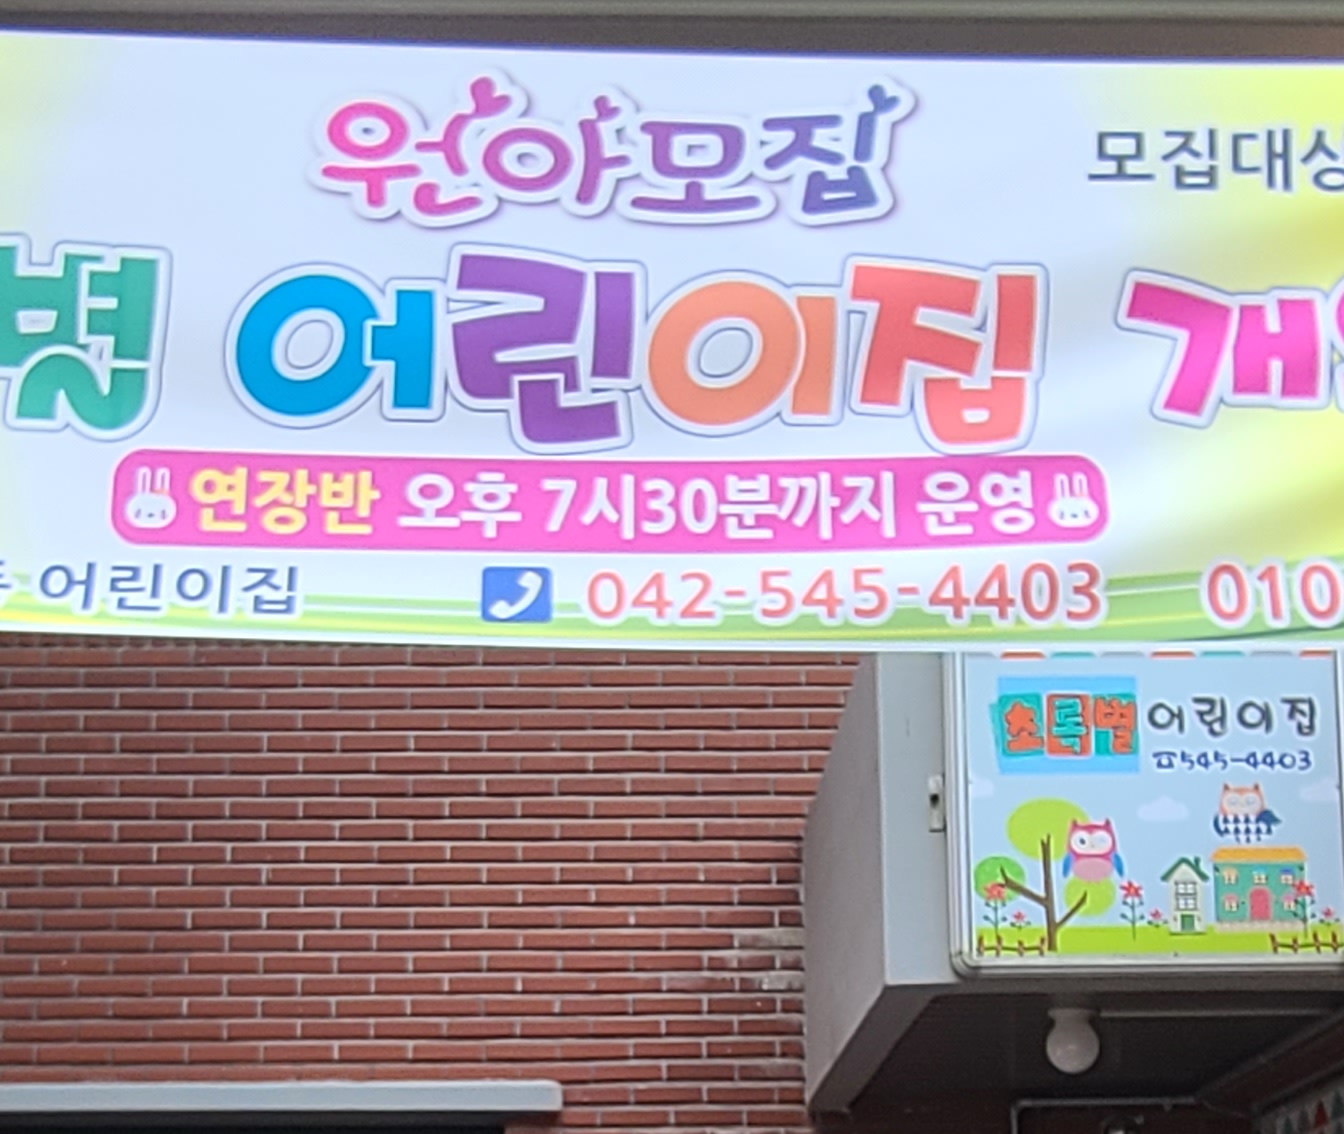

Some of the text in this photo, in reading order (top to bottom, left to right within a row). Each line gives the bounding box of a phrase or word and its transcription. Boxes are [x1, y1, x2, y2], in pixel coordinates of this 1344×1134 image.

[321, 76, 901, 215] 원아모집
[232, 250, 1042, 449] 어린이집
[188, 465, 1036, 541] 연장반 오후 7시30분까지 운영
[39, 562, 299, 614] 어린이집
[586, 561, 1104, 623] 042-545-4403
[1004, 695, 1316, 754] 초록별 어린이집
[1179, 750, 1312, 770] 545-4403
